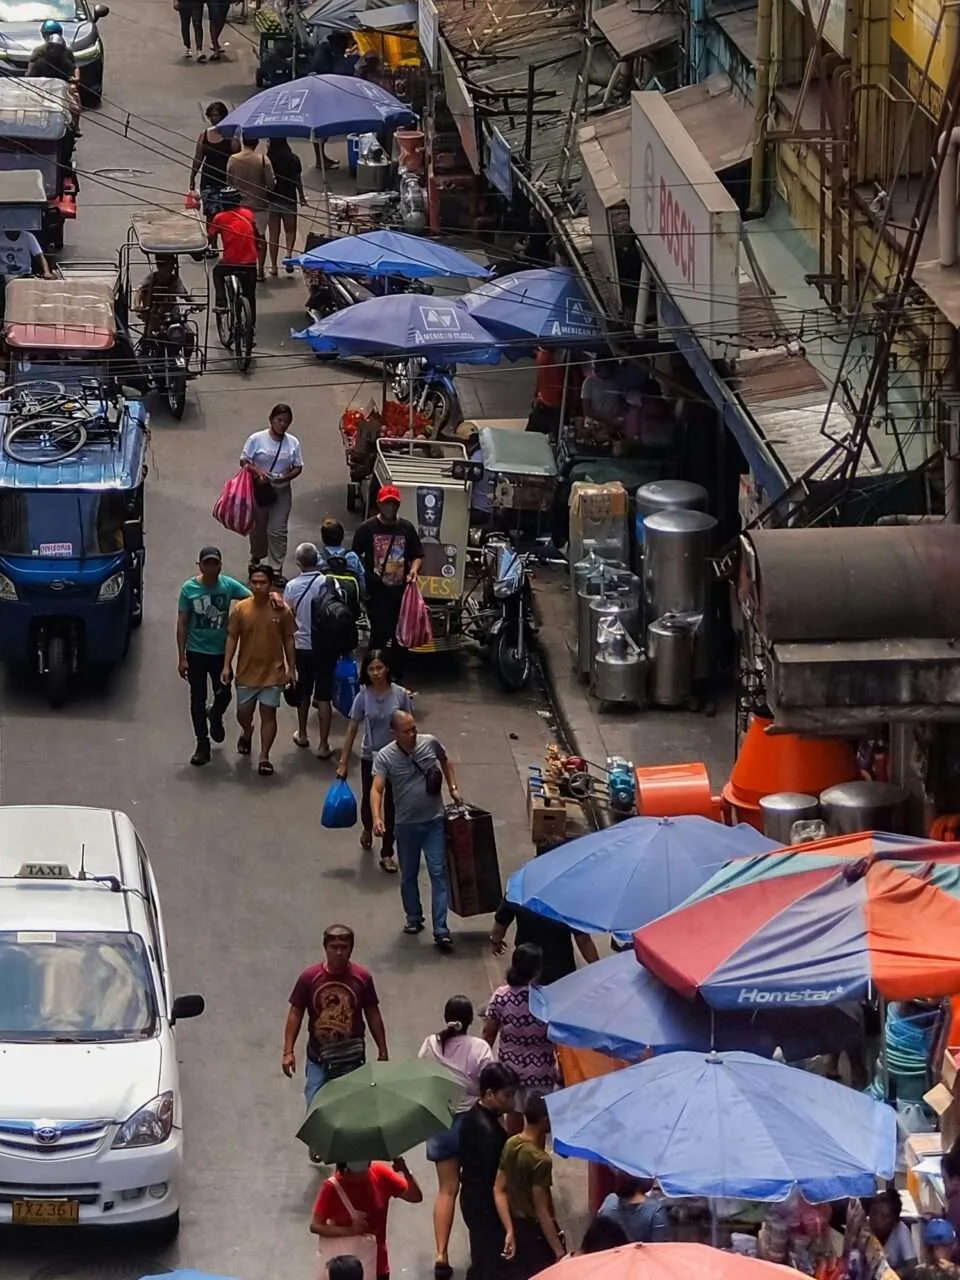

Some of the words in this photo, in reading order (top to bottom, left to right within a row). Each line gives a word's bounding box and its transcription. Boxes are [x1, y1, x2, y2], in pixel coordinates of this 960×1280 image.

[659, 175, 696, 290] BOSCH
[416, 577, 450, 595] YES
[25, 865, 64, 876] TAXI
[737, 987, 837, 1003] Homstar
